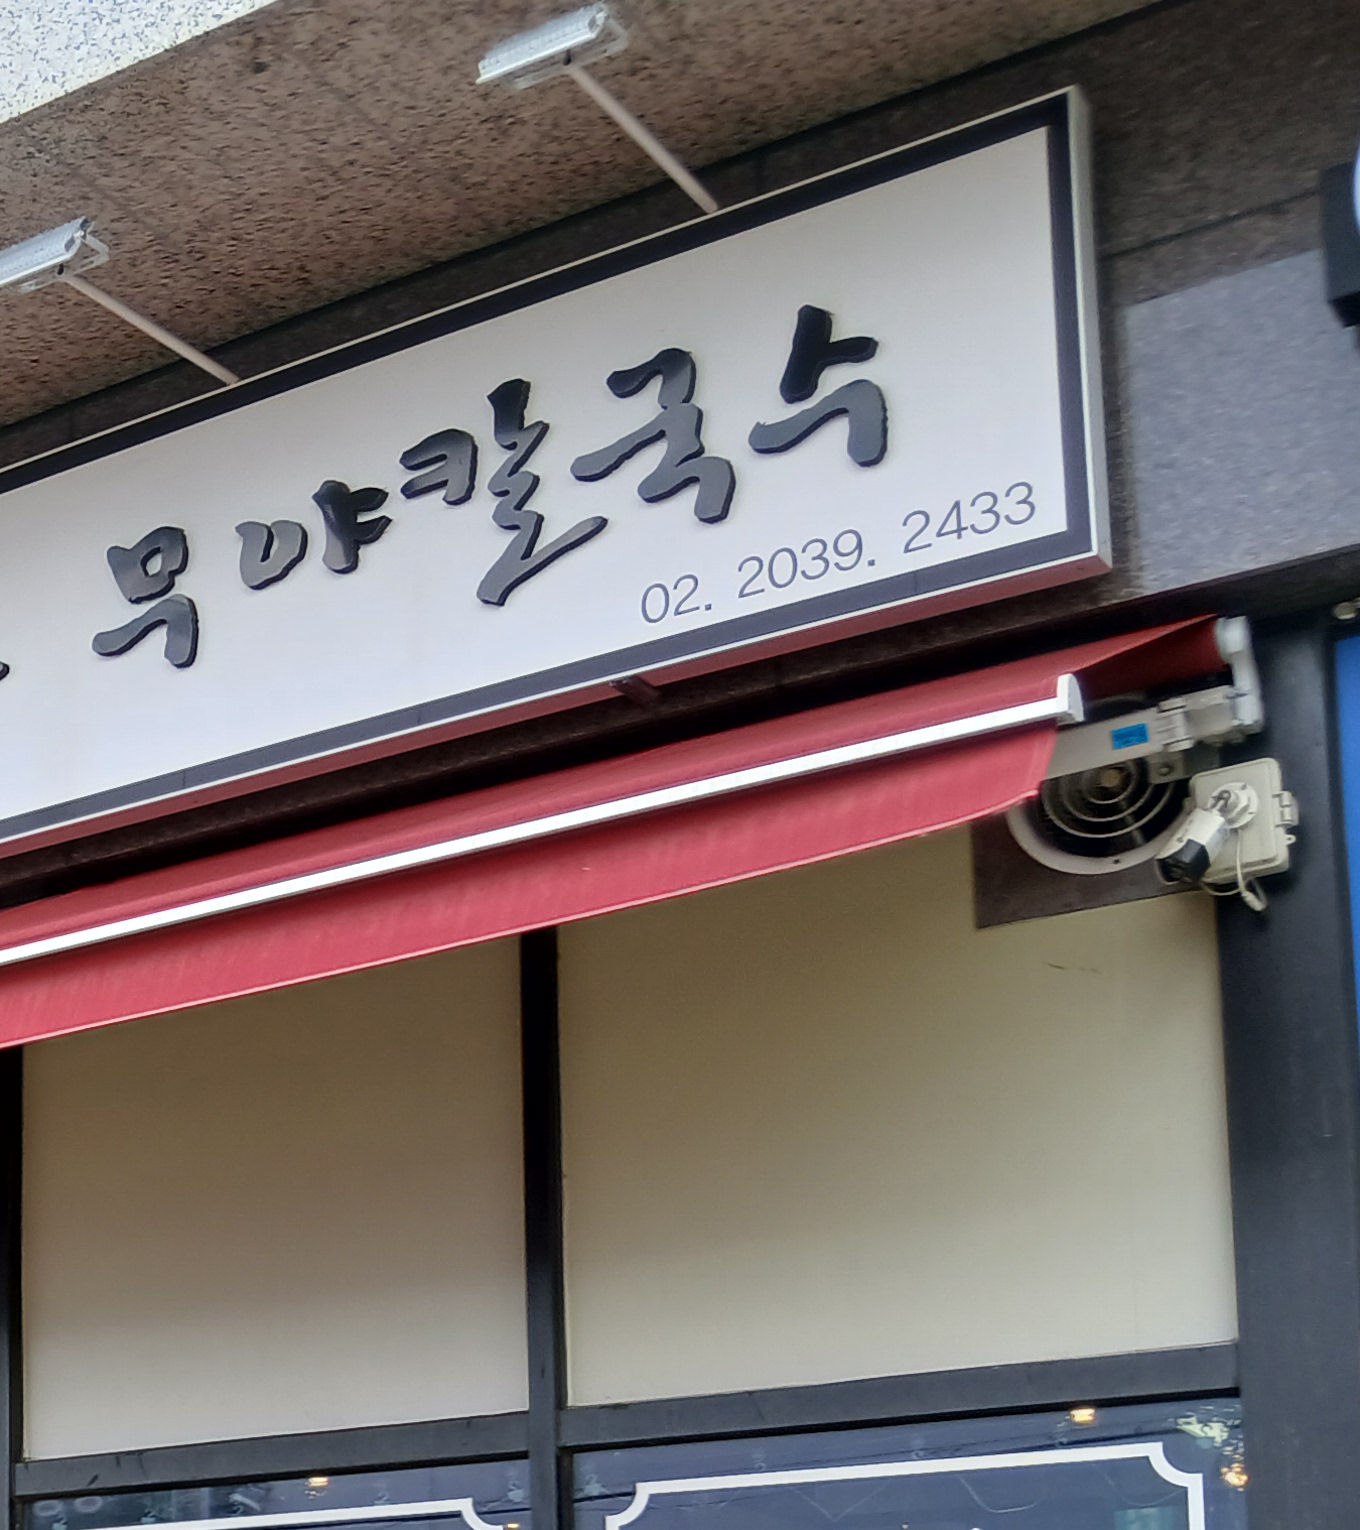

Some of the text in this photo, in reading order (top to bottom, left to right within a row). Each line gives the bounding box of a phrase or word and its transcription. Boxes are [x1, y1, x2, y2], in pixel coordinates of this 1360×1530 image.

[92, 304, 891, 669] 무야칼국수
[641, 480, 1038, 626] 02. 2039. 2433
